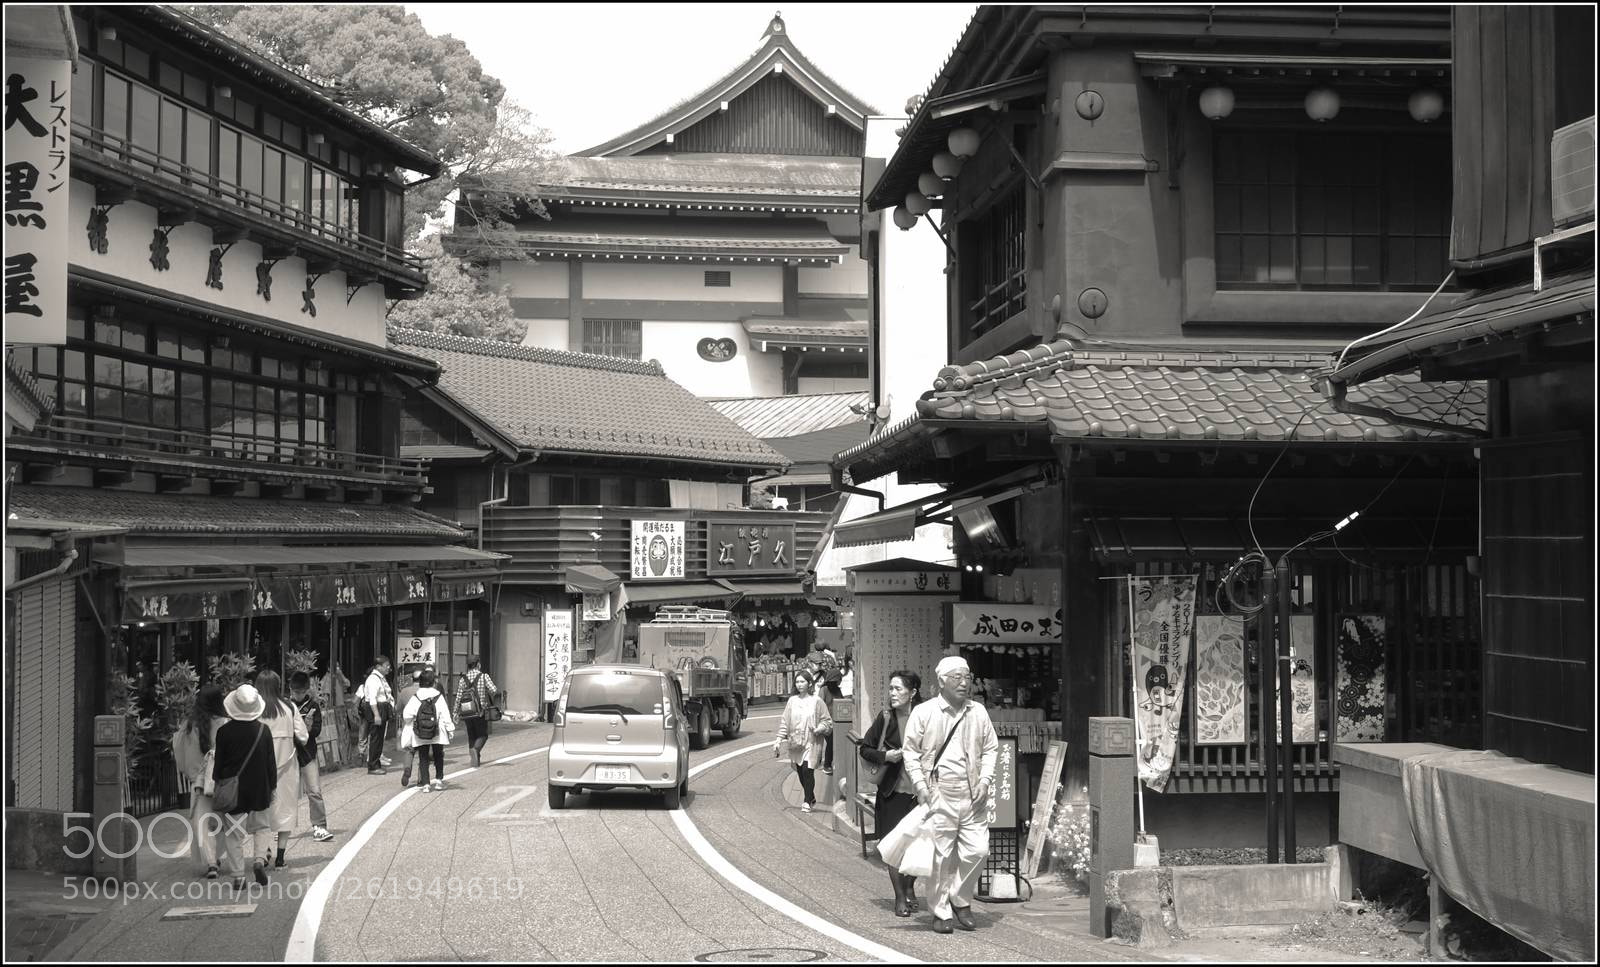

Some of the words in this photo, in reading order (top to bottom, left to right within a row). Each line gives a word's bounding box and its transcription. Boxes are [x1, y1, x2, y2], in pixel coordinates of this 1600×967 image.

[47, 80, 67, 193] レストラン
[5, 73, 49, 318] 大黒屋
[718, 539, 788, 566] 江戸久
[1181, 603, 1192, 637] 2017年
[401, 652, 432, 662] 大野屋
[1159, 621, 1170, 665] 全国優勝
